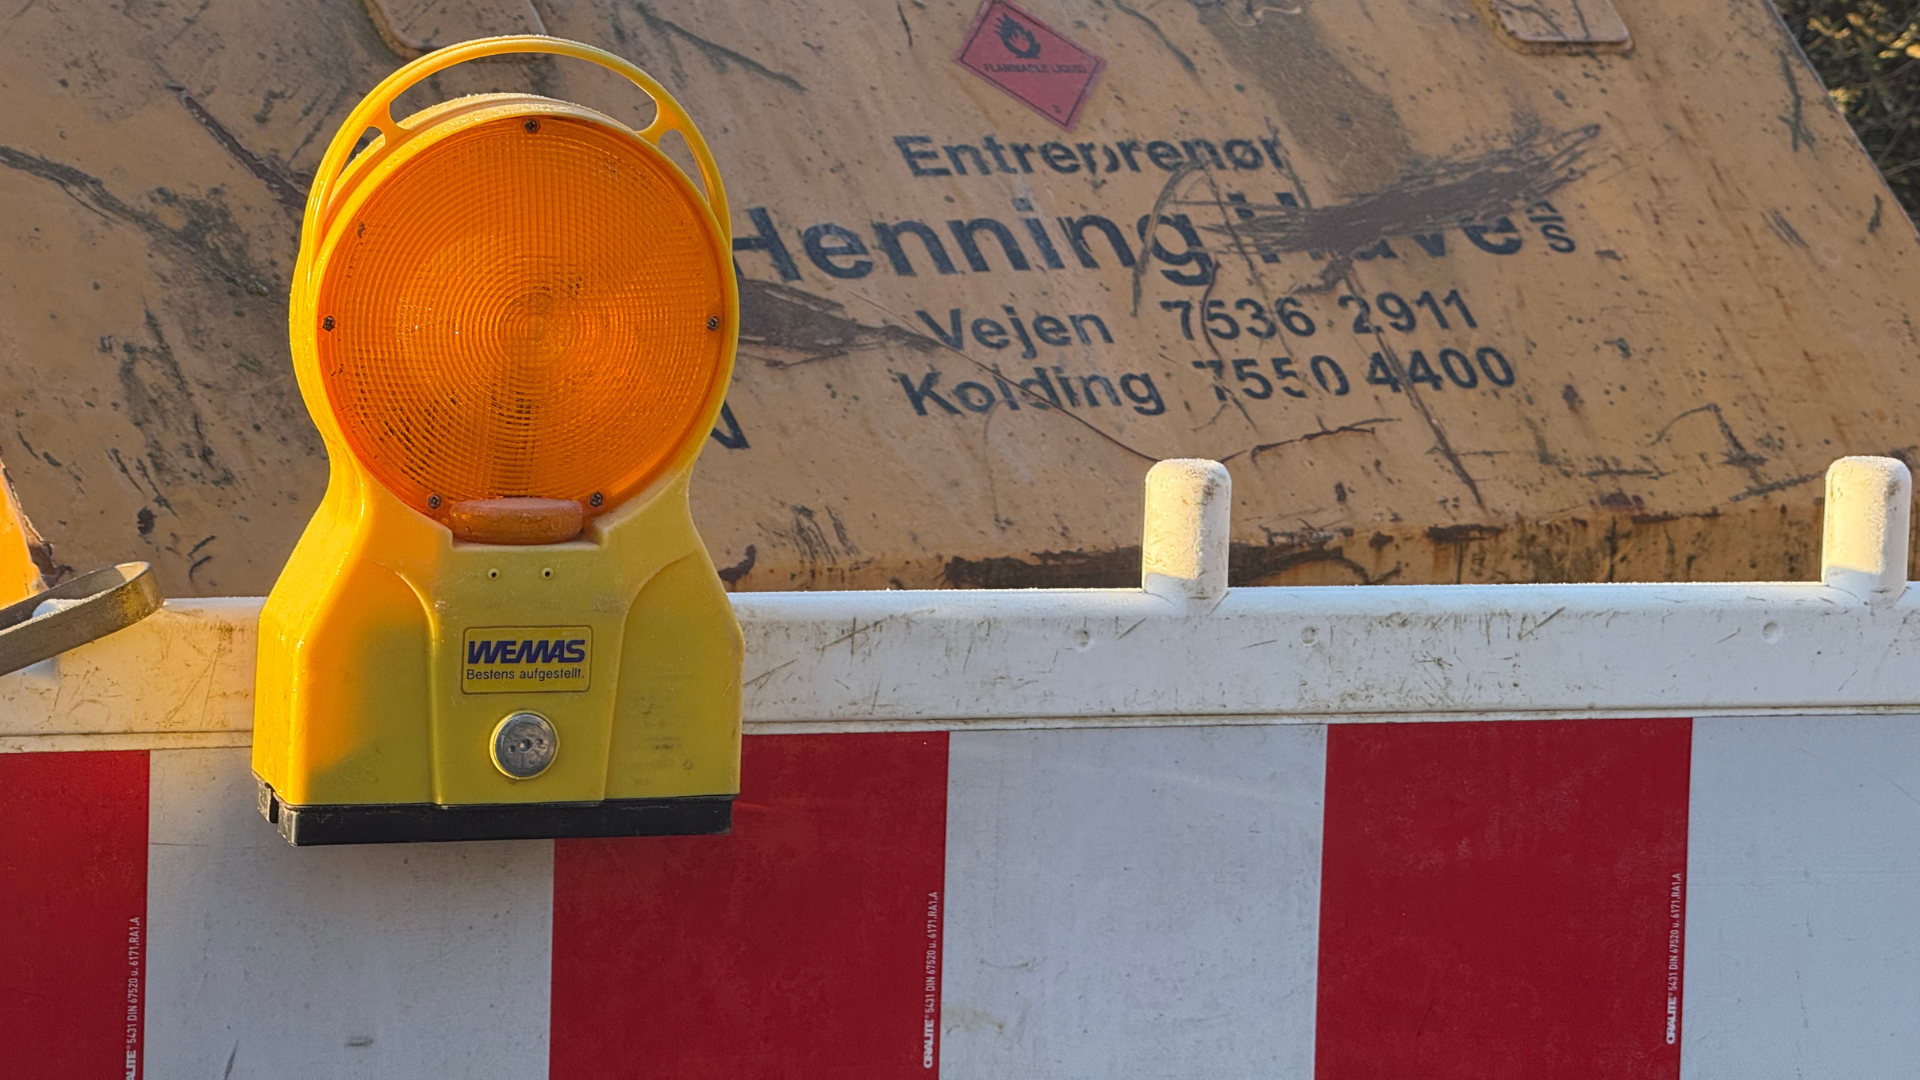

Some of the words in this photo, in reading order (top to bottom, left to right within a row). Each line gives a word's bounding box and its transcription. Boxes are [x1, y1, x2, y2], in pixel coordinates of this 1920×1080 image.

[914, 305, 1114, 359] Vejen
[1160, 297, 1316, 340] 7536
[1337, 289, 1478, 334] 2911
[900, 367, 1166, 416] Kolding
[1192, 354, 1350, 401] 7550
[1366, 346, 1515, 393] 4400
[467, 639, 586, 664] WEMAS
[466, 669, 515, 680] Bestens
[519, 667, 584, 681] aufgestellt.
[1669, 929, 1679, 954] 67520
[926, 949, 936, 974] 67520
[1669, 955, 1679, 970] DIN
[127, 977, 138, 1003] 67520
[925, 976, 936, 992] DIN
[1668, 972, 1678, 991] 5431
[127, 1005, 137, 1021] DIN
[924, 993, 935, 1013] 5431
[126, 1023, 137, 1043] 5431
